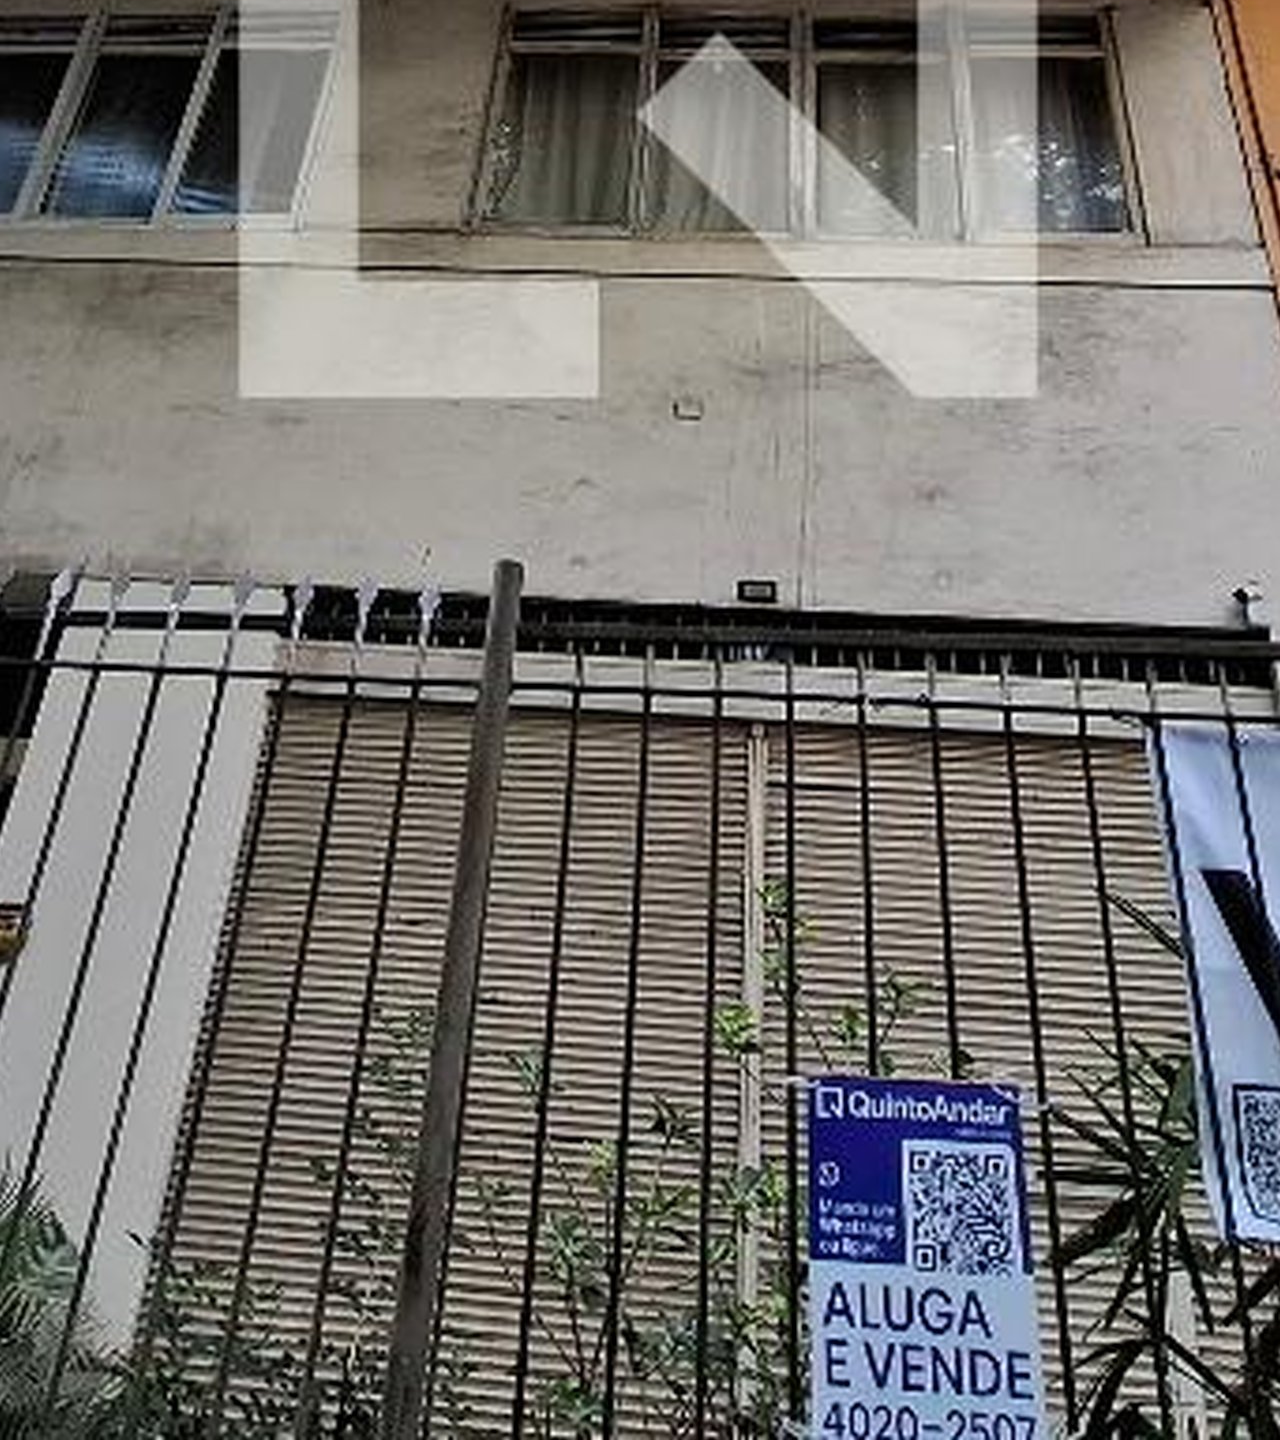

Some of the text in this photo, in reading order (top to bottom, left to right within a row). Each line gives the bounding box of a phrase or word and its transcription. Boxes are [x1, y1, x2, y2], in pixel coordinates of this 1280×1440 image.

[847, 1090, 1012, 1126] QuintoAndar
[823, 1281, 993, 1339] ALUGA
[825, 1338, 1036, 1400] E VENDE
[822, 1401, 1039, 1440] 4020-2507
